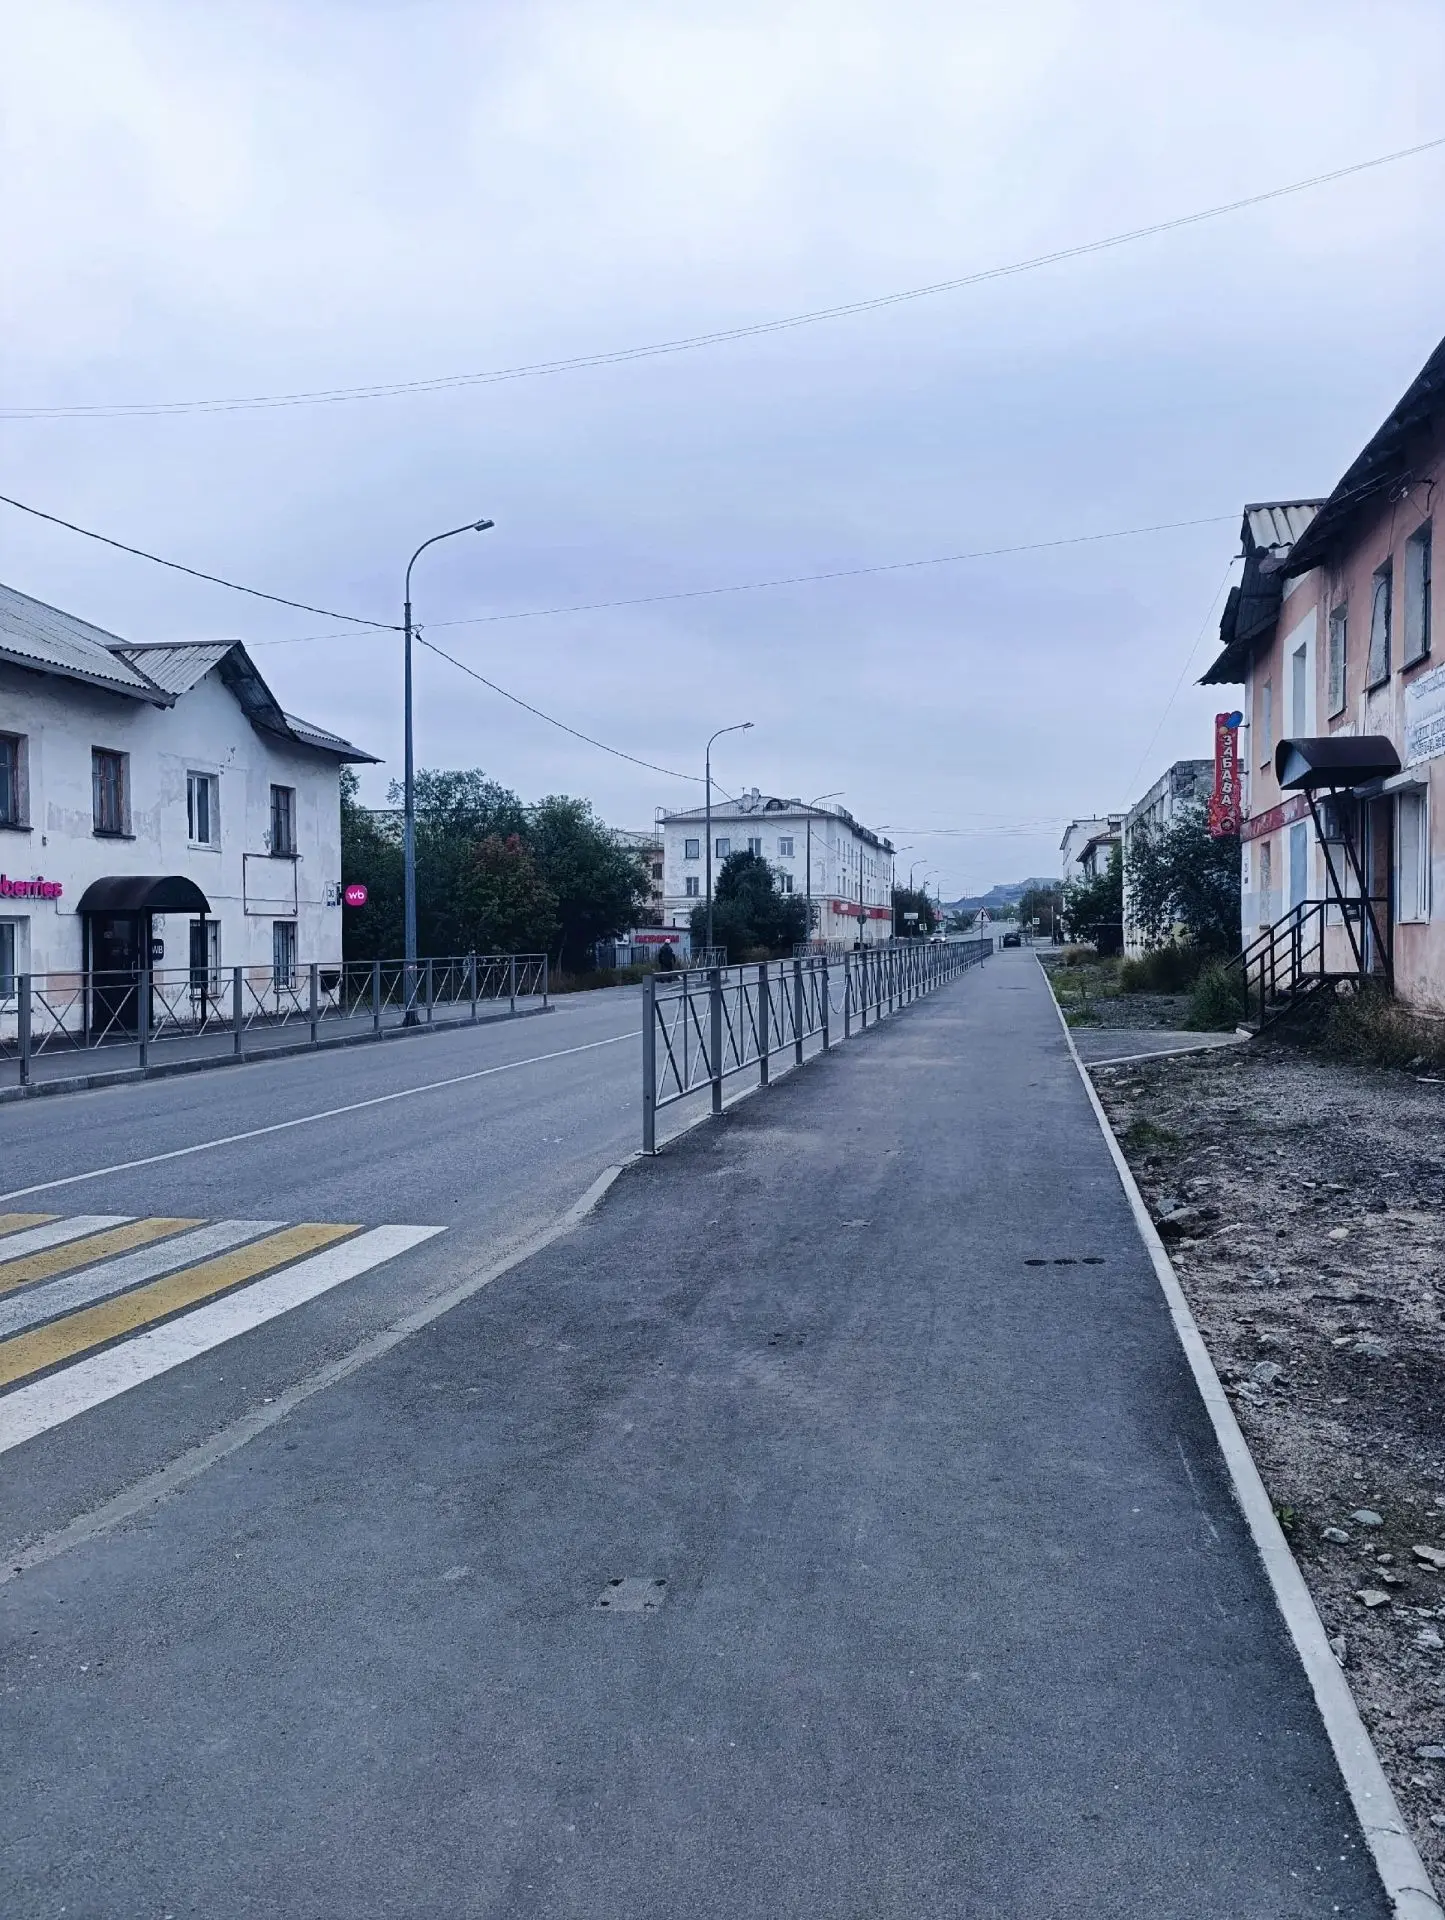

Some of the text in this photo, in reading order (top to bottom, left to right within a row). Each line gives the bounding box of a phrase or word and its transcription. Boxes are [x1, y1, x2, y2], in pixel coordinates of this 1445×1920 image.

[1221, 735, 1233, 806] ЗАБАВА
[0, 874, 62, 896] berries
[348, 889, 365, 899] wb
